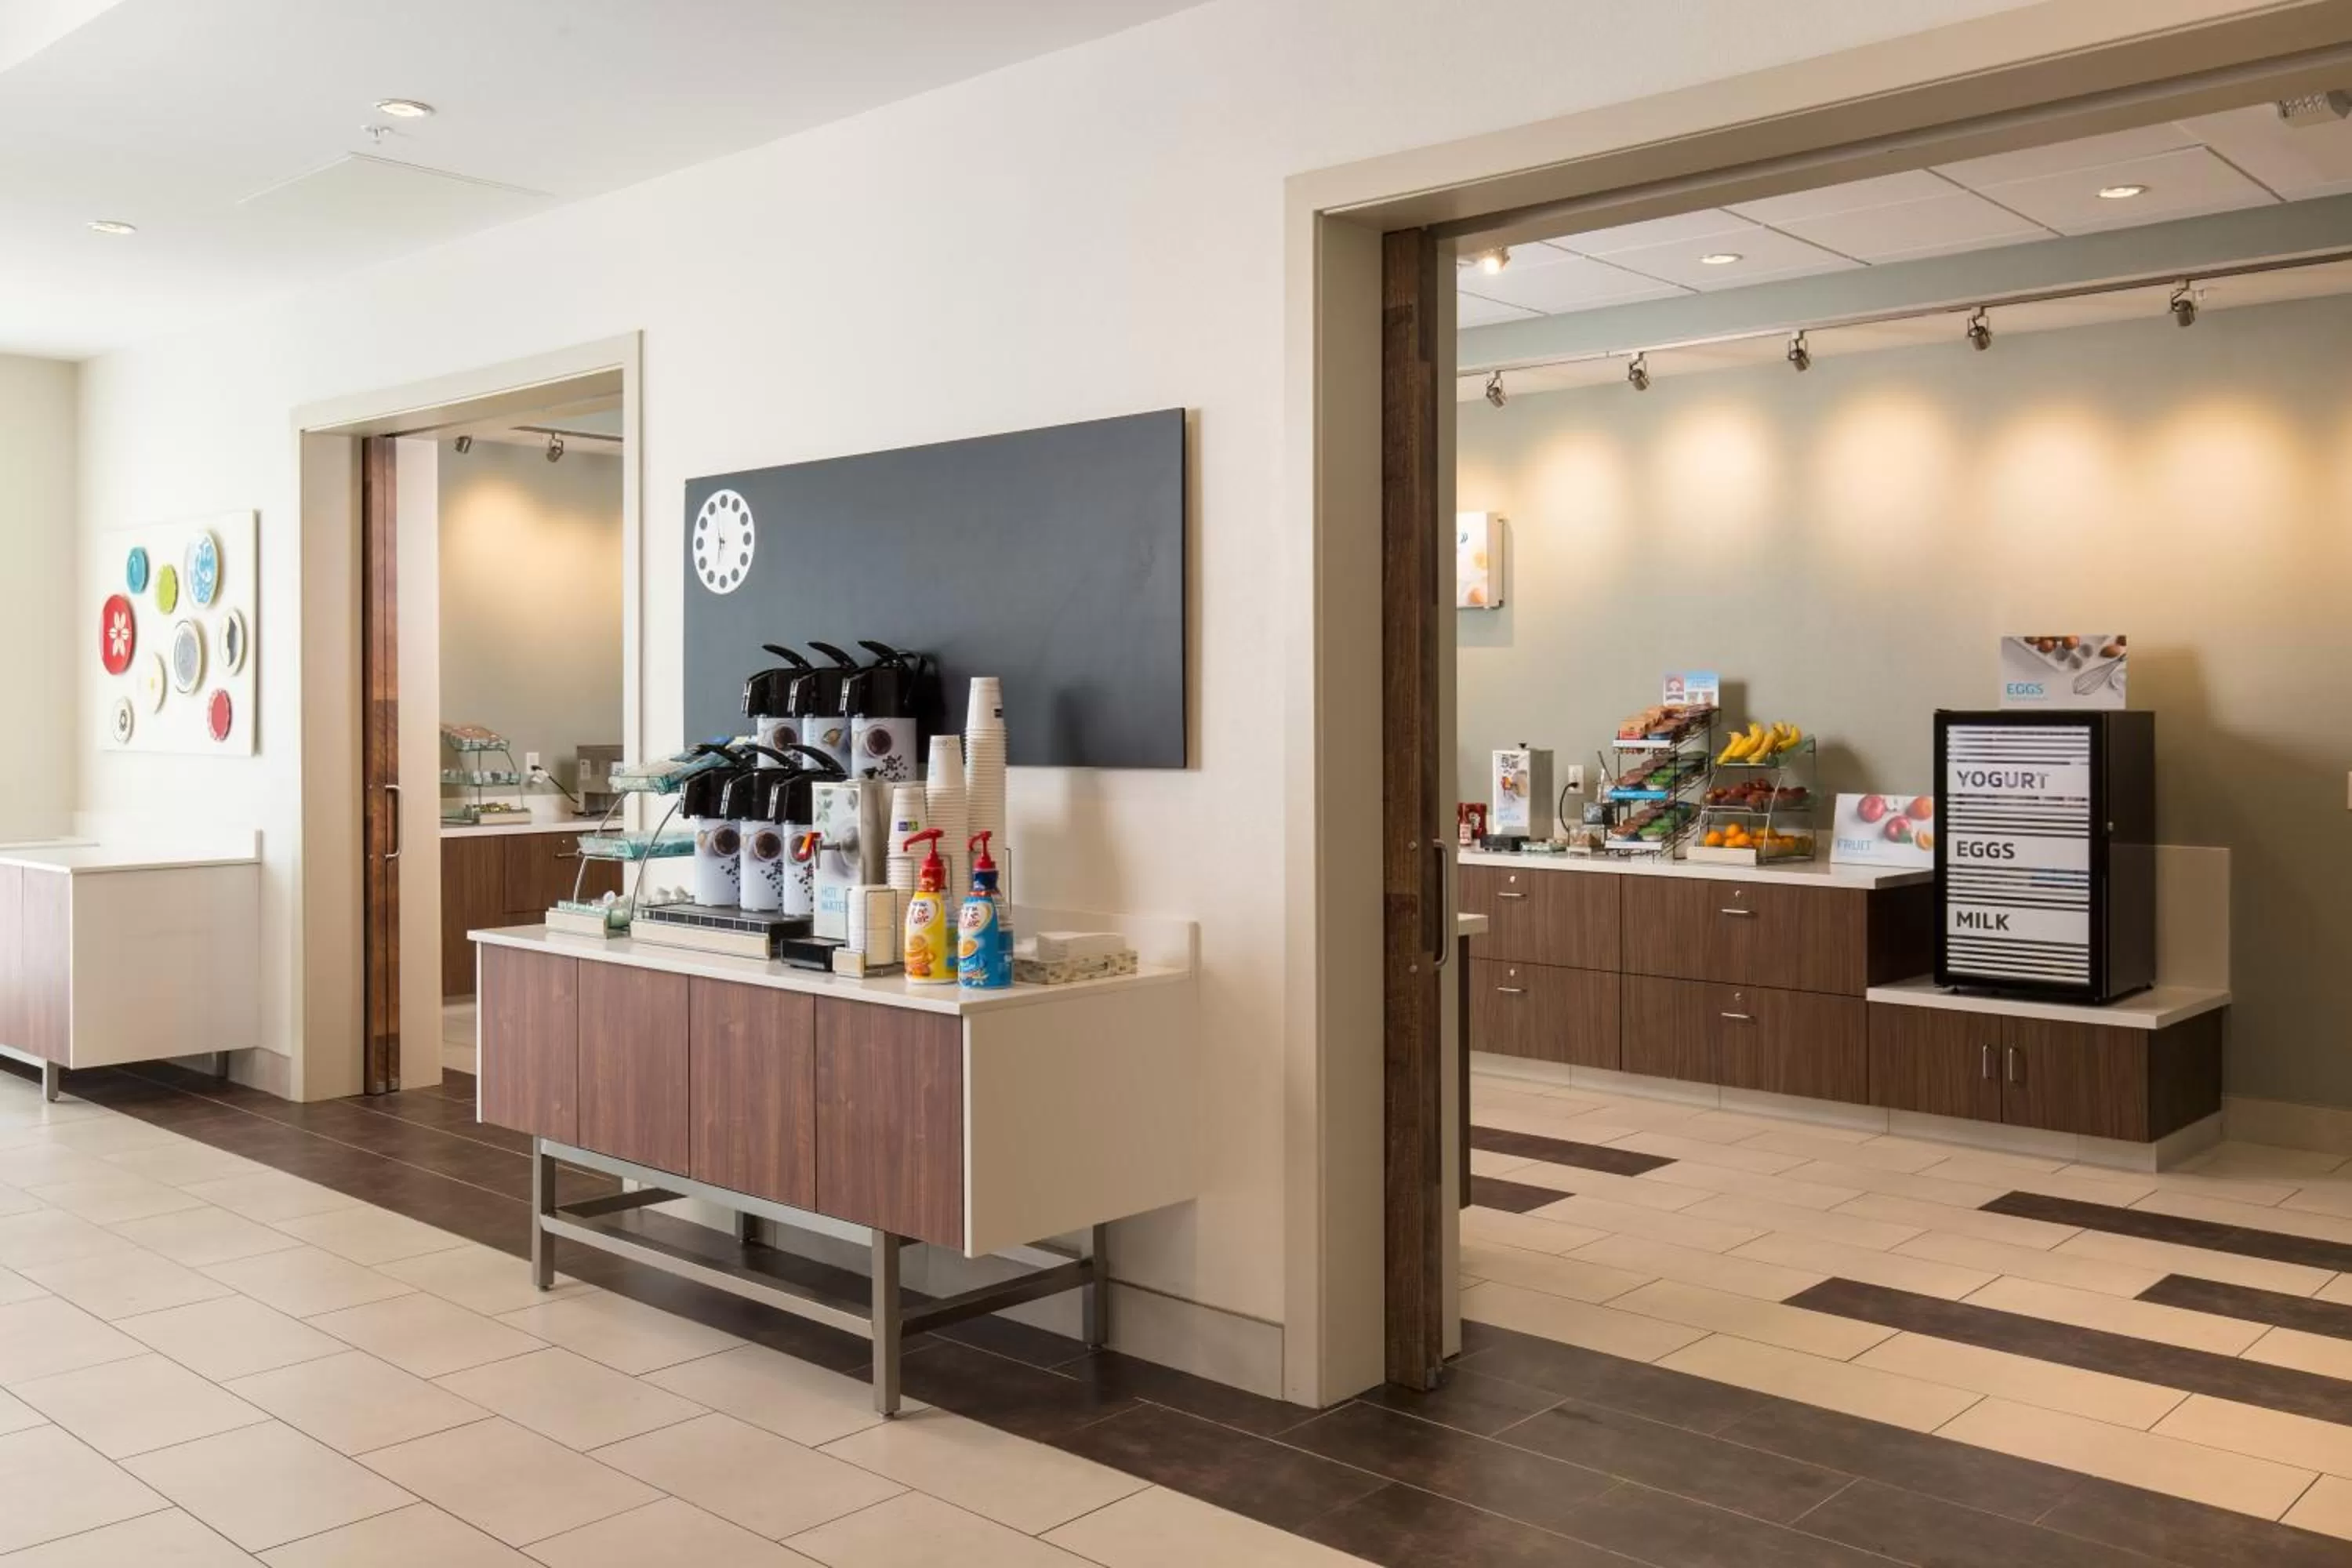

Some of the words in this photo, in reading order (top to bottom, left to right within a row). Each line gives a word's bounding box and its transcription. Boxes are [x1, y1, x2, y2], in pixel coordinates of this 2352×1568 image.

[2006, 682, 2045, 695] EGGS
[1957, 770, 2051, 789] YOGURT
[1837, 838, 1872, 851] FRUIT
[1956, 840, 2016, 859] EGGS
[821, 886, 837, 899] HOT
[821, 899, 848, 913] WATE
[1956, 910, 2010, 931] MILK
